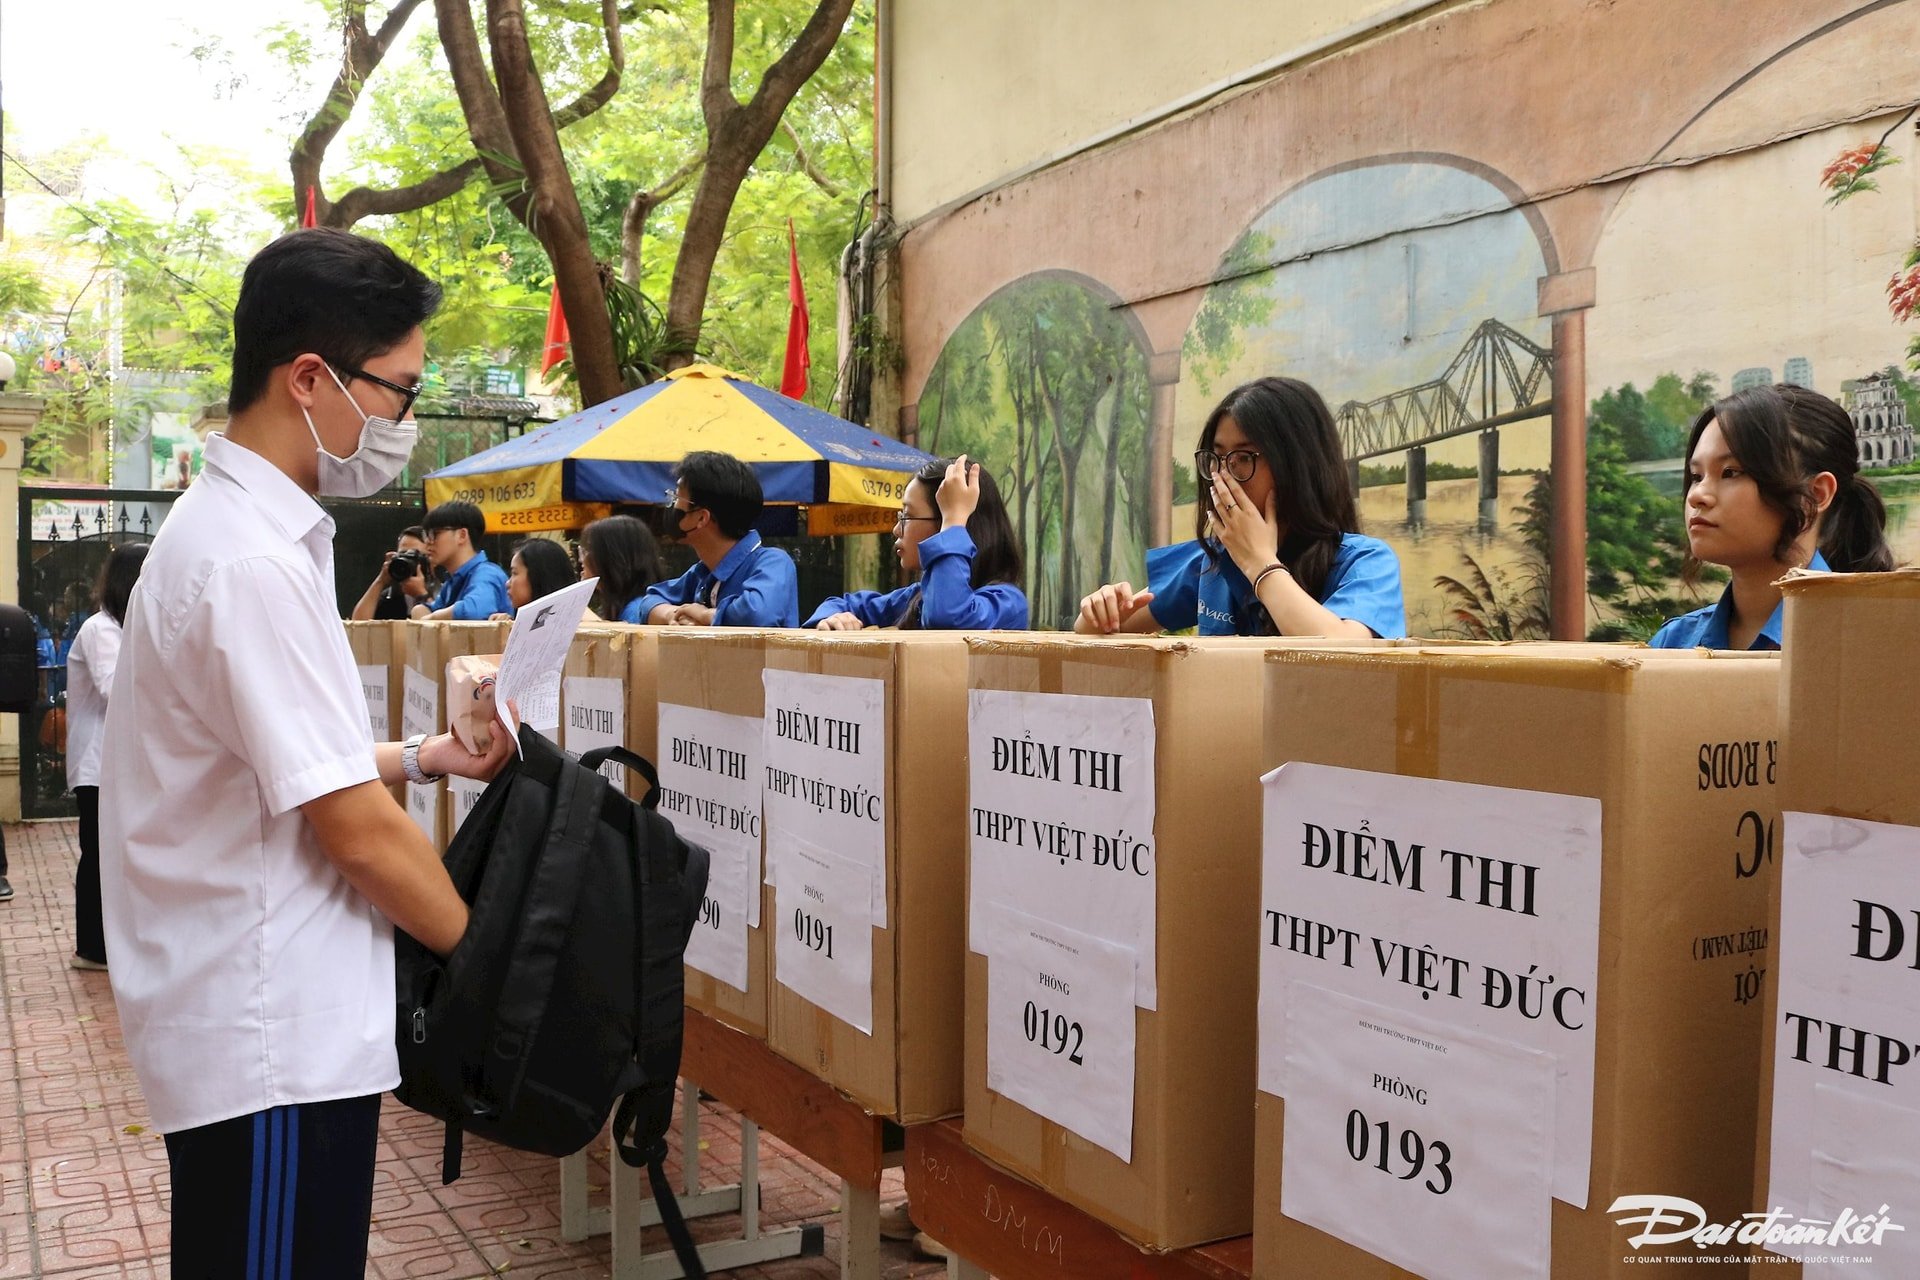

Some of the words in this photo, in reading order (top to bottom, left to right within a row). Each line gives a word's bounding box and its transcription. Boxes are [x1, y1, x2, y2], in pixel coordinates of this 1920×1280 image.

[489, 485, 511, 502] 106
[514, 481, 536, 499] 633
[862, 478, 891, 498] 0379
[595, 709, 613, 734] THI
[775, 702, 819, 746] ĐIỂM
[824, 718, 861, 755] THI
[672, 734, 712, 772] ĐIỂM
[716, 748, 747, 781] THI
[992, 729, 1061, 783] ĐIỂM
[1069, 747, 1124, 793] THI
[1698, 740, 1760, 791] RODS
[660, 787, 692, 815] THPT
[696, 798, 726, 830] VIỆT
[730, 805, 760, 838] ĐỨC
[765, 766, 798, 798] THPT
[801, 777, 836, 814] VIỆT
[840, 784, 881, 822] ĐỨC
[973, 807, 1026, 847] THPT
[1032, 821, 1086, 866] VIỆT
[1092, 829, 1150, 877] ĐỨC
[1736, 810, 1774, 879] C
[1301, 819, 1426, 893] ĐIỂM
[1440, 849, 1541, 918] THI
[699, 896, 720, 930] 90
[795, 908, 834, 960] 0191
[1266, 909, 1360, 969] THPT
[1370, 944, 1471, 1001] VIỆT
[1481, 964, 1587, 1031] ĐỨC
[1702, 933, 1735, 960] NAM
[1040, 972, 1070, 996] PHÒNG
[1024, 1001, 1084, 1067] 0192
[1372, 1073, 1428, 1106] PHÒNG
[1346, 1109, 1453, 1195] 0193
